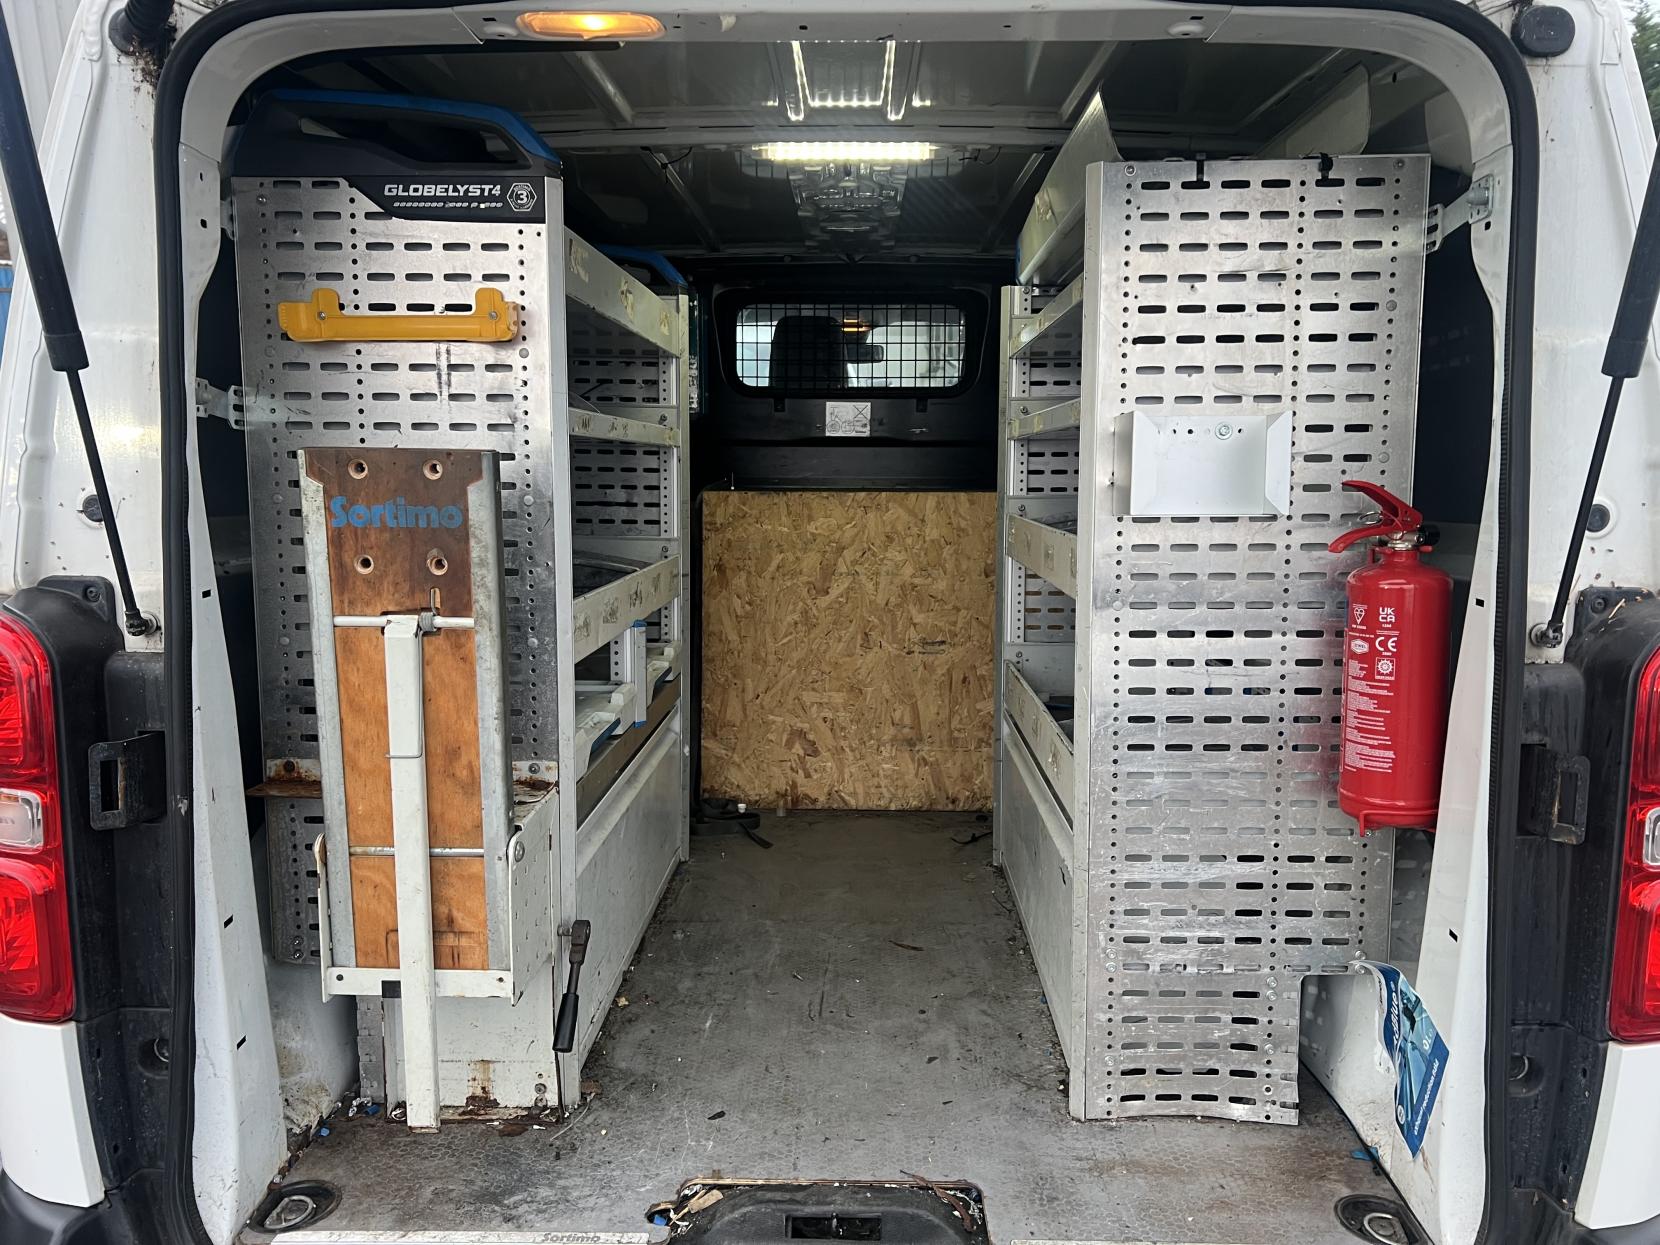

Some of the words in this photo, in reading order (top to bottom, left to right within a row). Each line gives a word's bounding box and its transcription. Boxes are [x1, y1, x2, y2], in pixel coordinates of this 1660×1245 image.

[384, 184, 501, 197] GLOBELYST4
[517, 190, 528, 204] 3
[329, 495, 463, 528] Sortimo
[1379, 606, 1395, 615] UK
[1378, 614, 1396, 622] CA
[1375, 636, 1398, 652] CE
[542, 1233, 601, 1243] Sortimo
